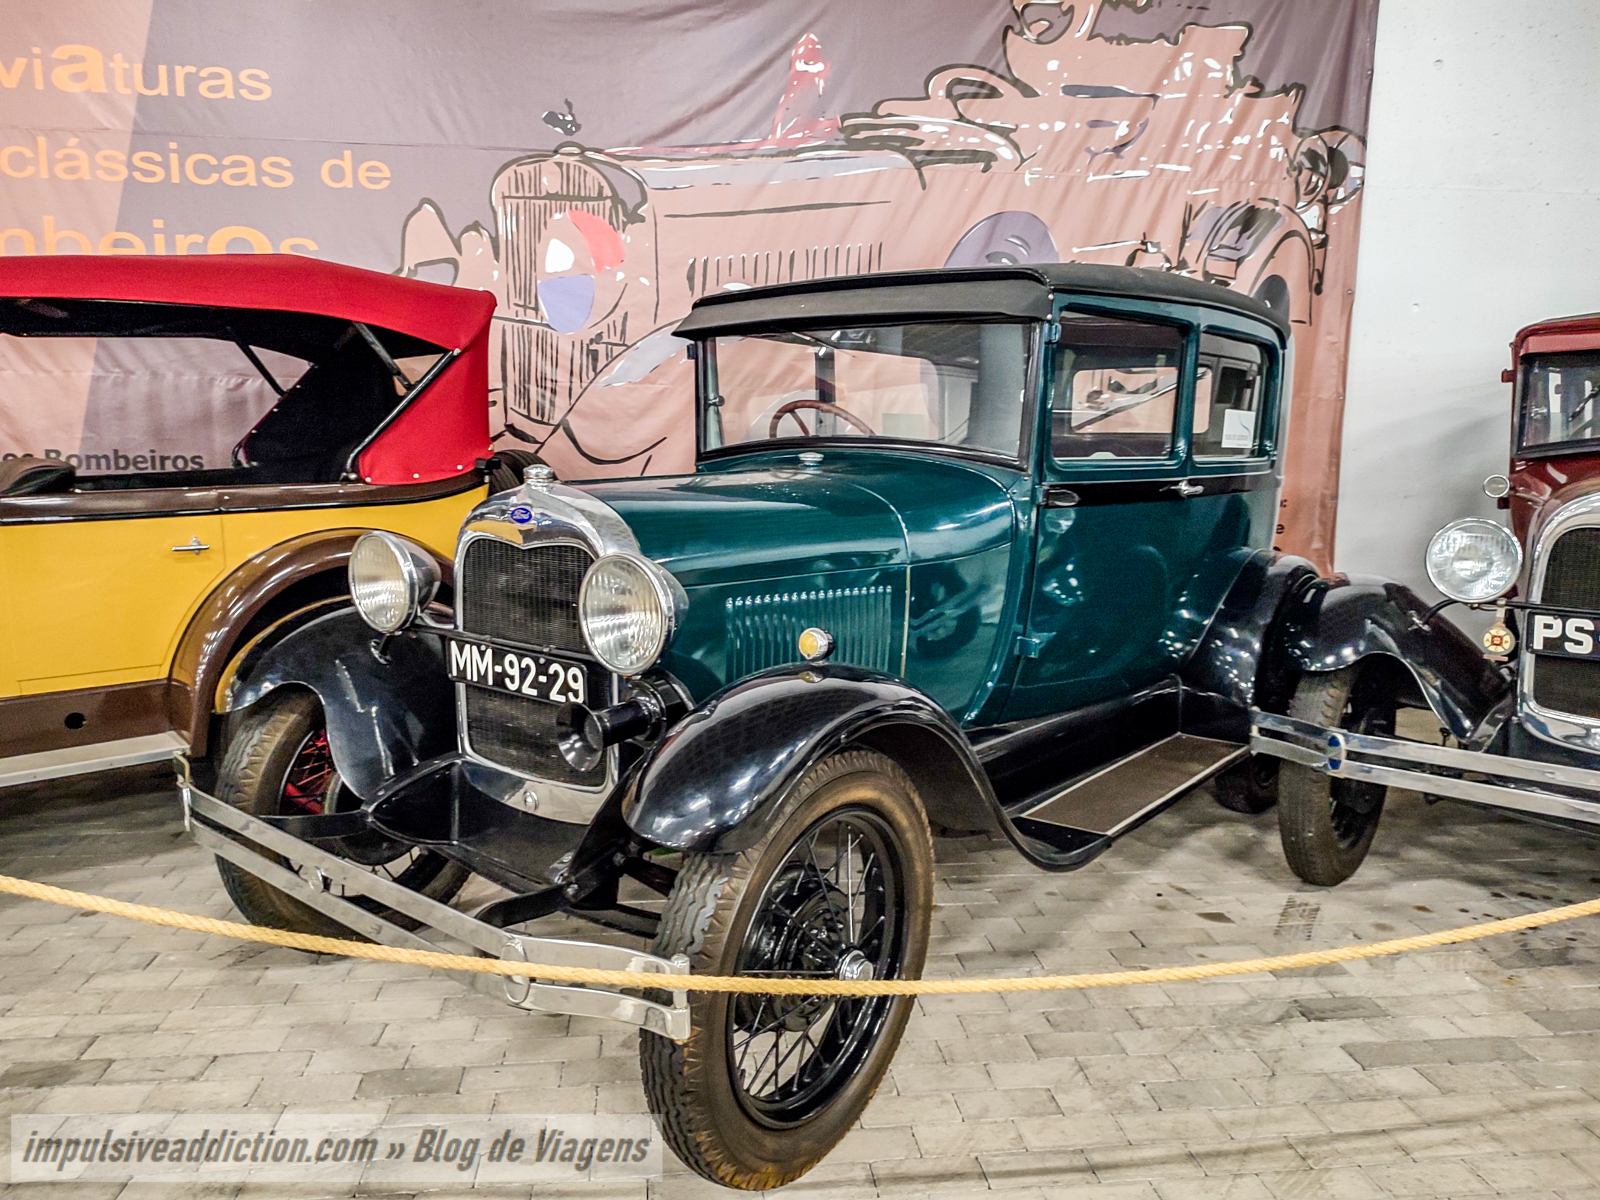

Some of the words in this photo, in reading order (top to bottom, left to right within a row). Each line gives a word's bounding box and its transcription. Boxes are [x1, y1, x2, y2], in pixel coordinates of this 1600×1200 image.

[0, 44, 272, 101] viaturas
[0, 136, 294, 188] clássicas
[320, 150, 392, 190] de
[1533, 615, 1600, 655] PS
[450, 640, 585, 704] MM-92-29
